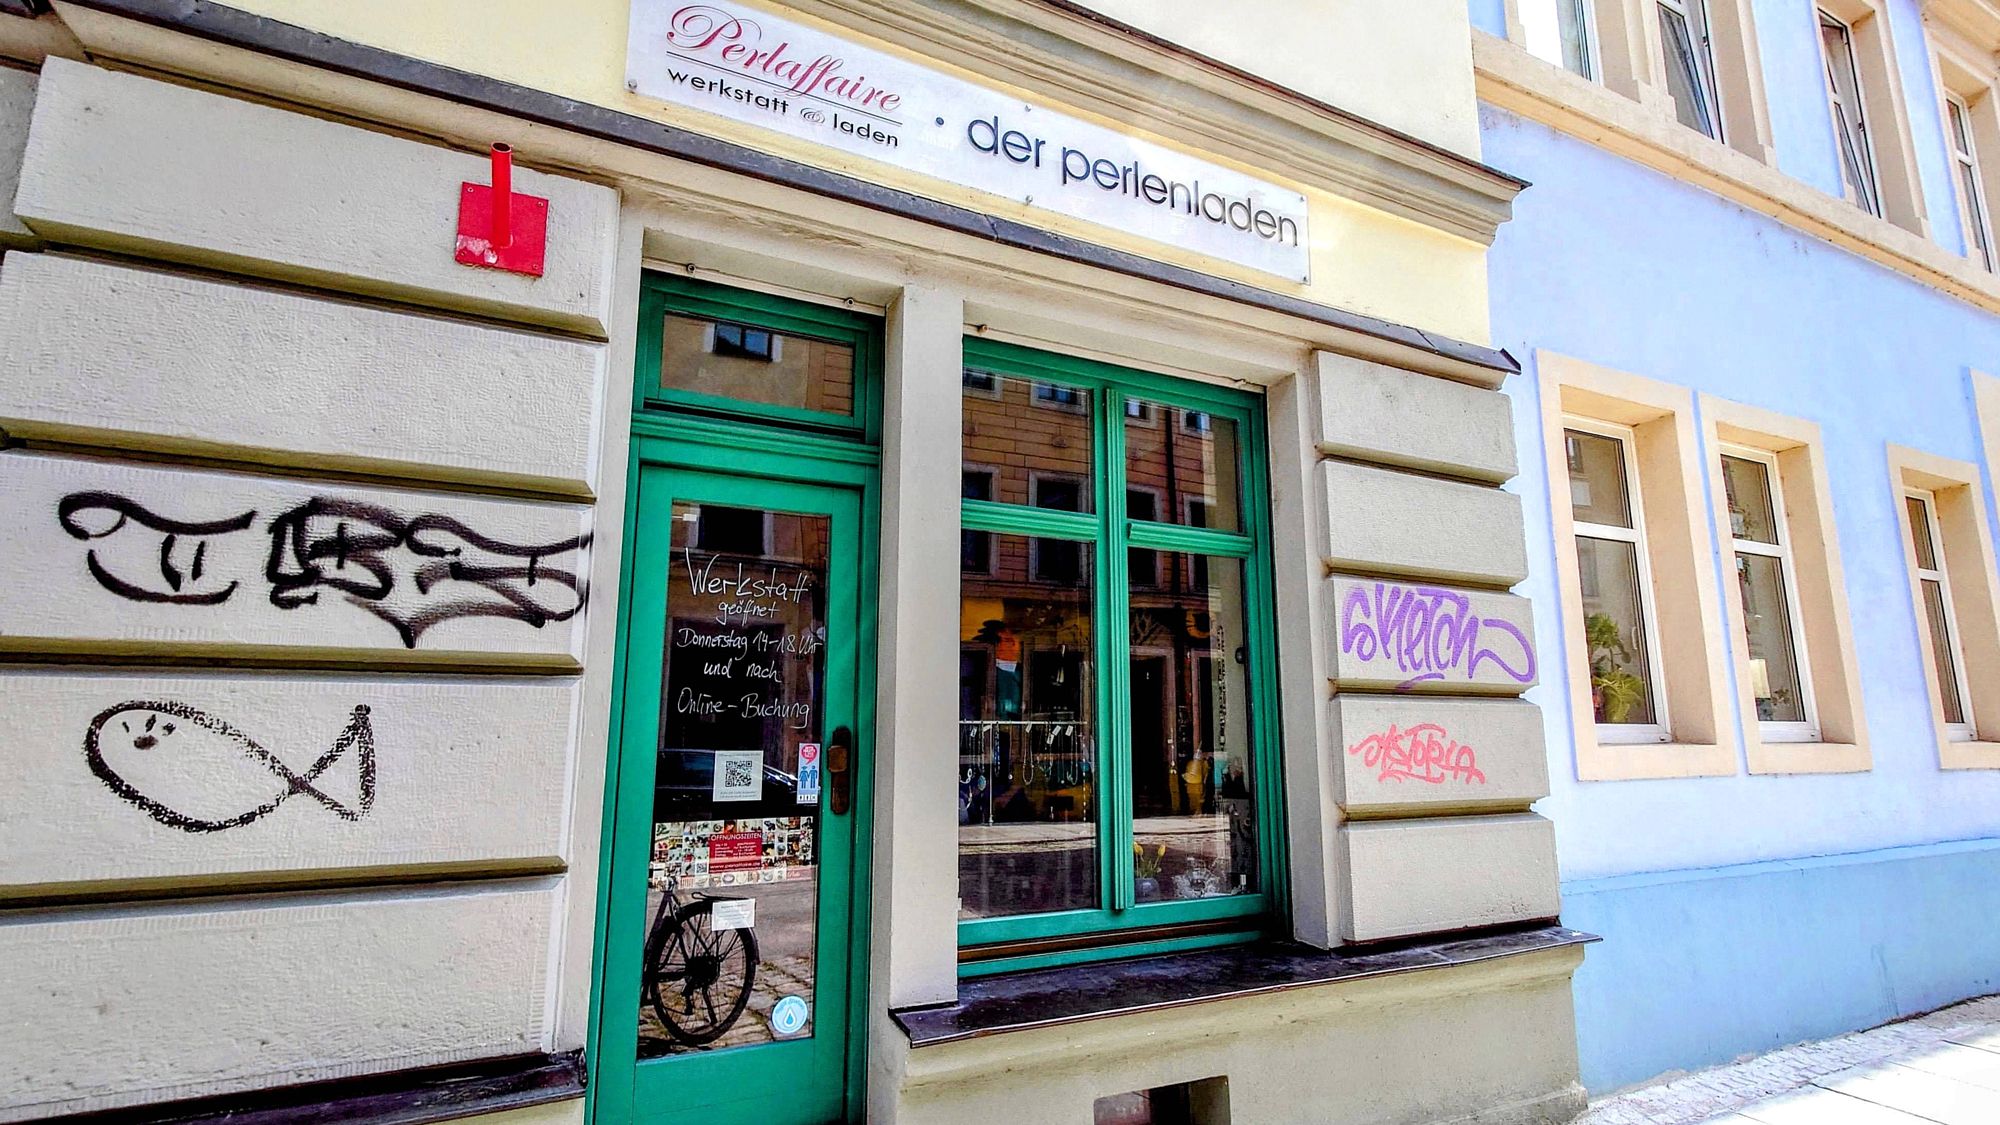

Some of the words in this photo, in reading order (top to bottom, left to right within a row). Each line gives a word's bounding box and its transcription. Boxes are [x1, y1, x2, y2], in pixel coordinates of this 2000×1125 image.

[667, 5, 901, 112] Perlaffaire
[668, 68, 790, 114] werkstatt
[833, 113, 899, 147] laden
[967, 116, 1046, 168] der
[1061, 146, 1298, 247] perlenladen
[686, 547, 809, 603] Werkstatt
[716, 601, 779, 625] geöffnet
[677, 628, 747, 660] Donnerstag
[703, 657, 732, 680] und
[745, 659, 782, 683] nach
